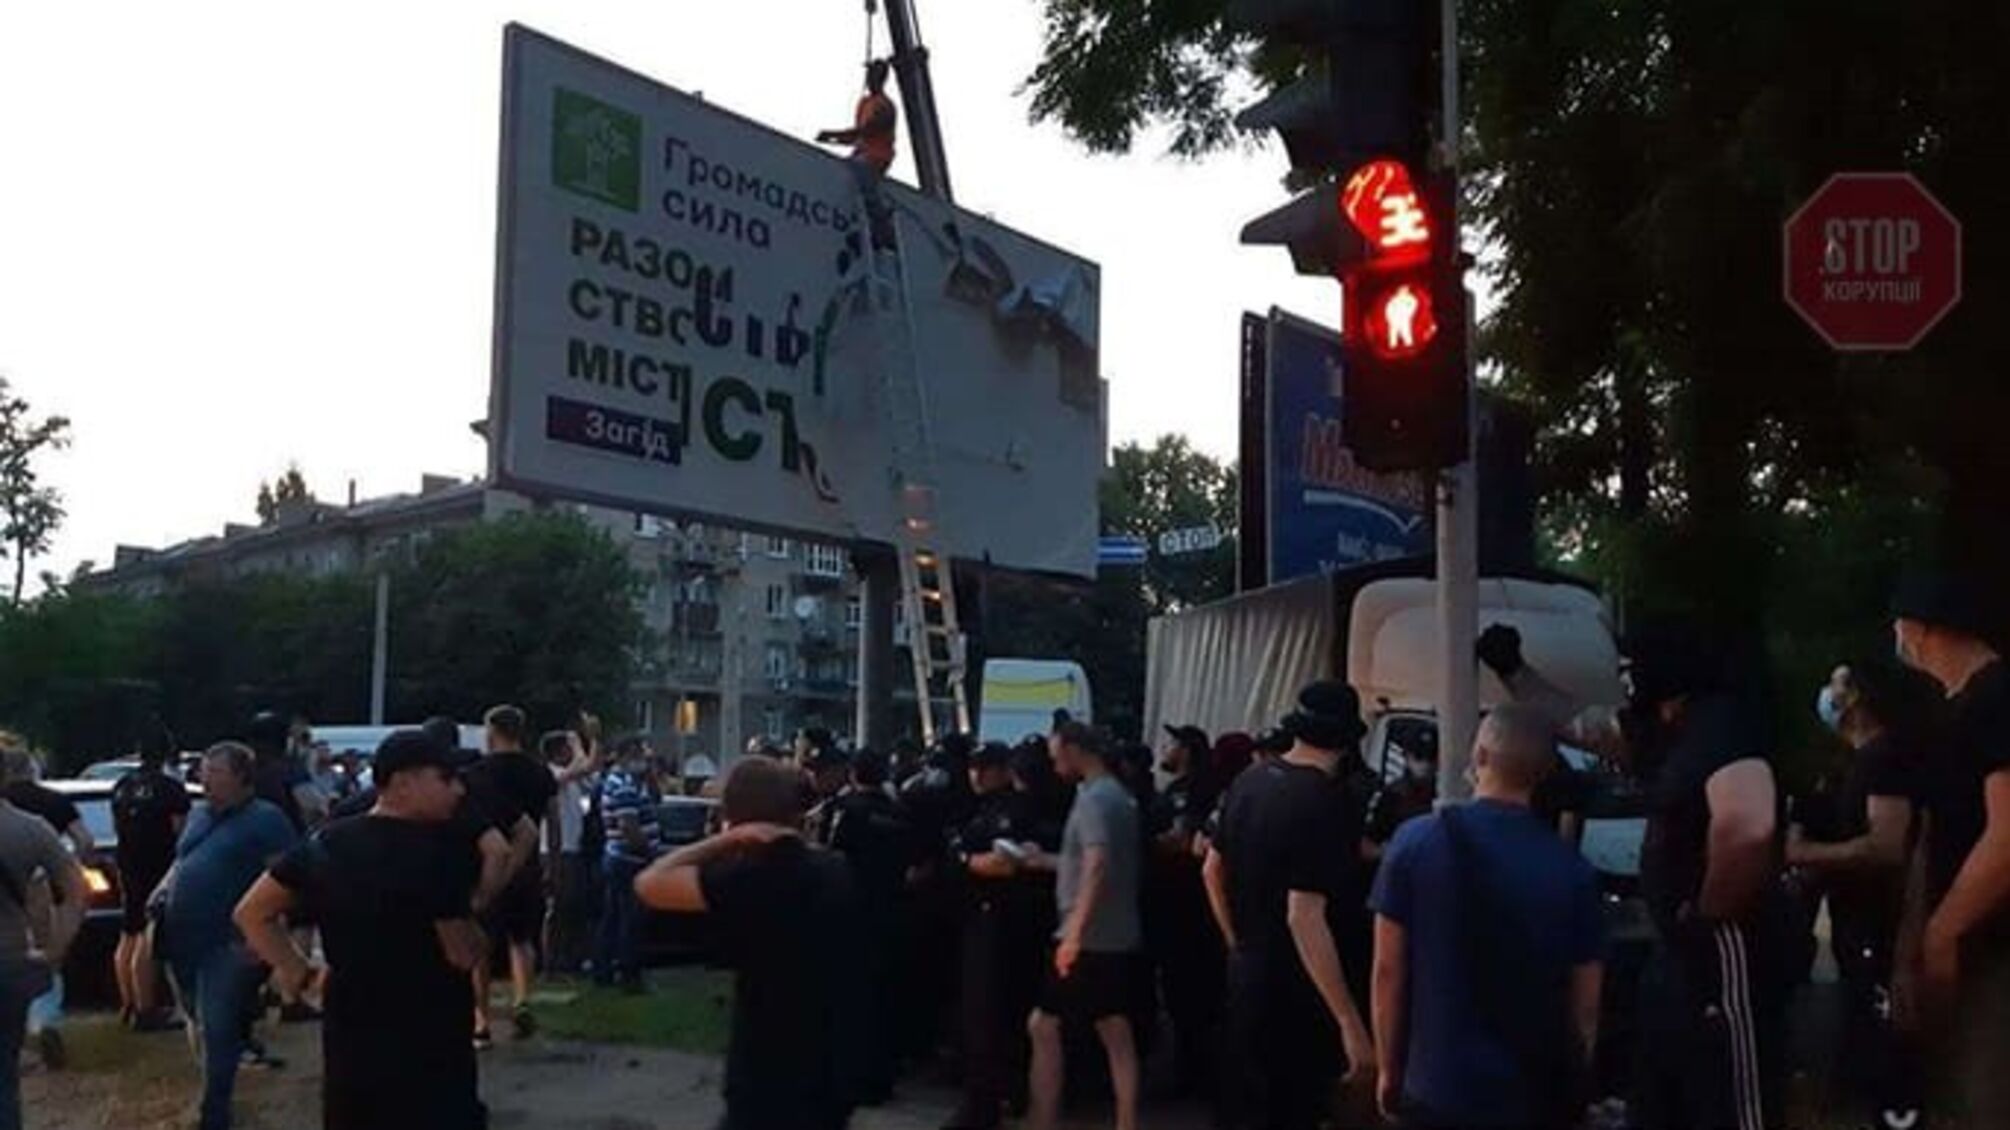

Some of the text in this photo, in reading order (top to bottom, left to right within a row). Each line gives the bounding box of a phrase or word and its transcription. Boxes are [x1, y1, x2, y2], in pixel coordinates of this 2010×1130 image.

[663, 136, 857, 232] Громадсь
[662, 189, 771, 249] сила
[568, 337, 682, 401] МІСТ
